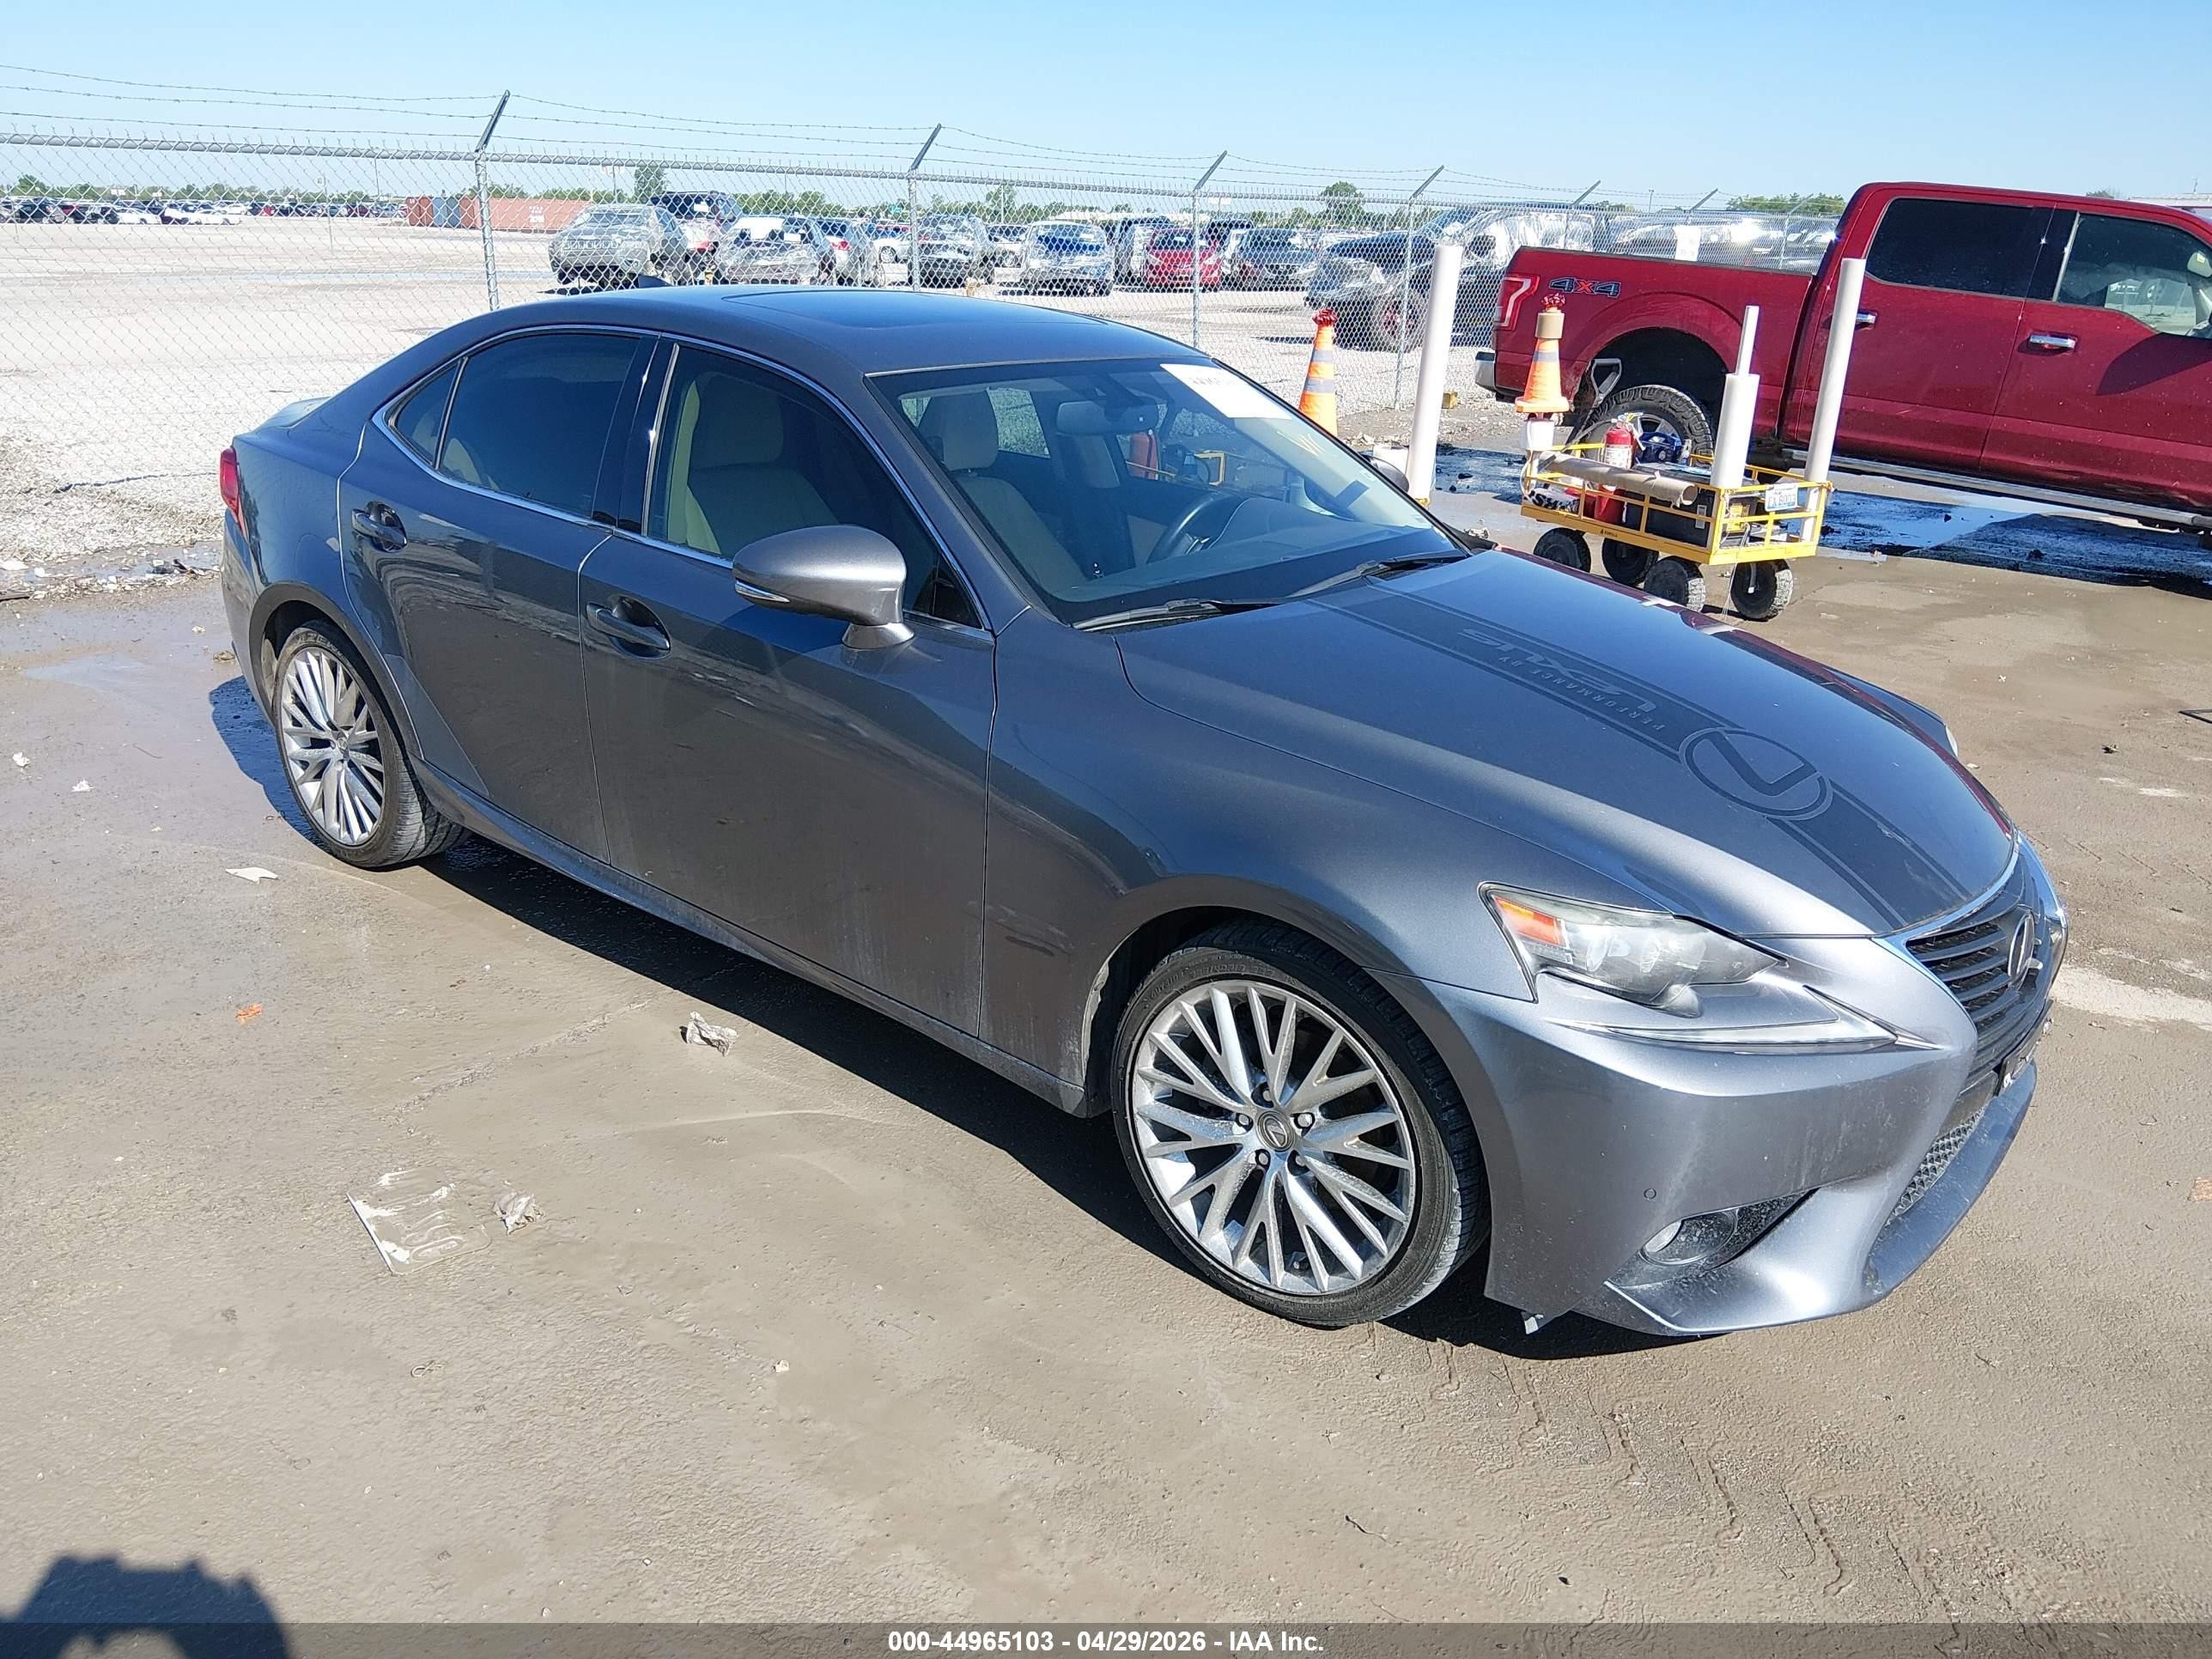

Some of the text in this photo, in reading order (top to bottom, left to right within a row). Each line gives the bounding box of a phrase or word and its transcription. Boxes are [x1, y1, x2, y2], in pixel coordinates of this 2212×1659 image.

[1457, 629, 1656, 713] LEXUS
[1498, 656, 1667, 731] PERFORMANCE BY
